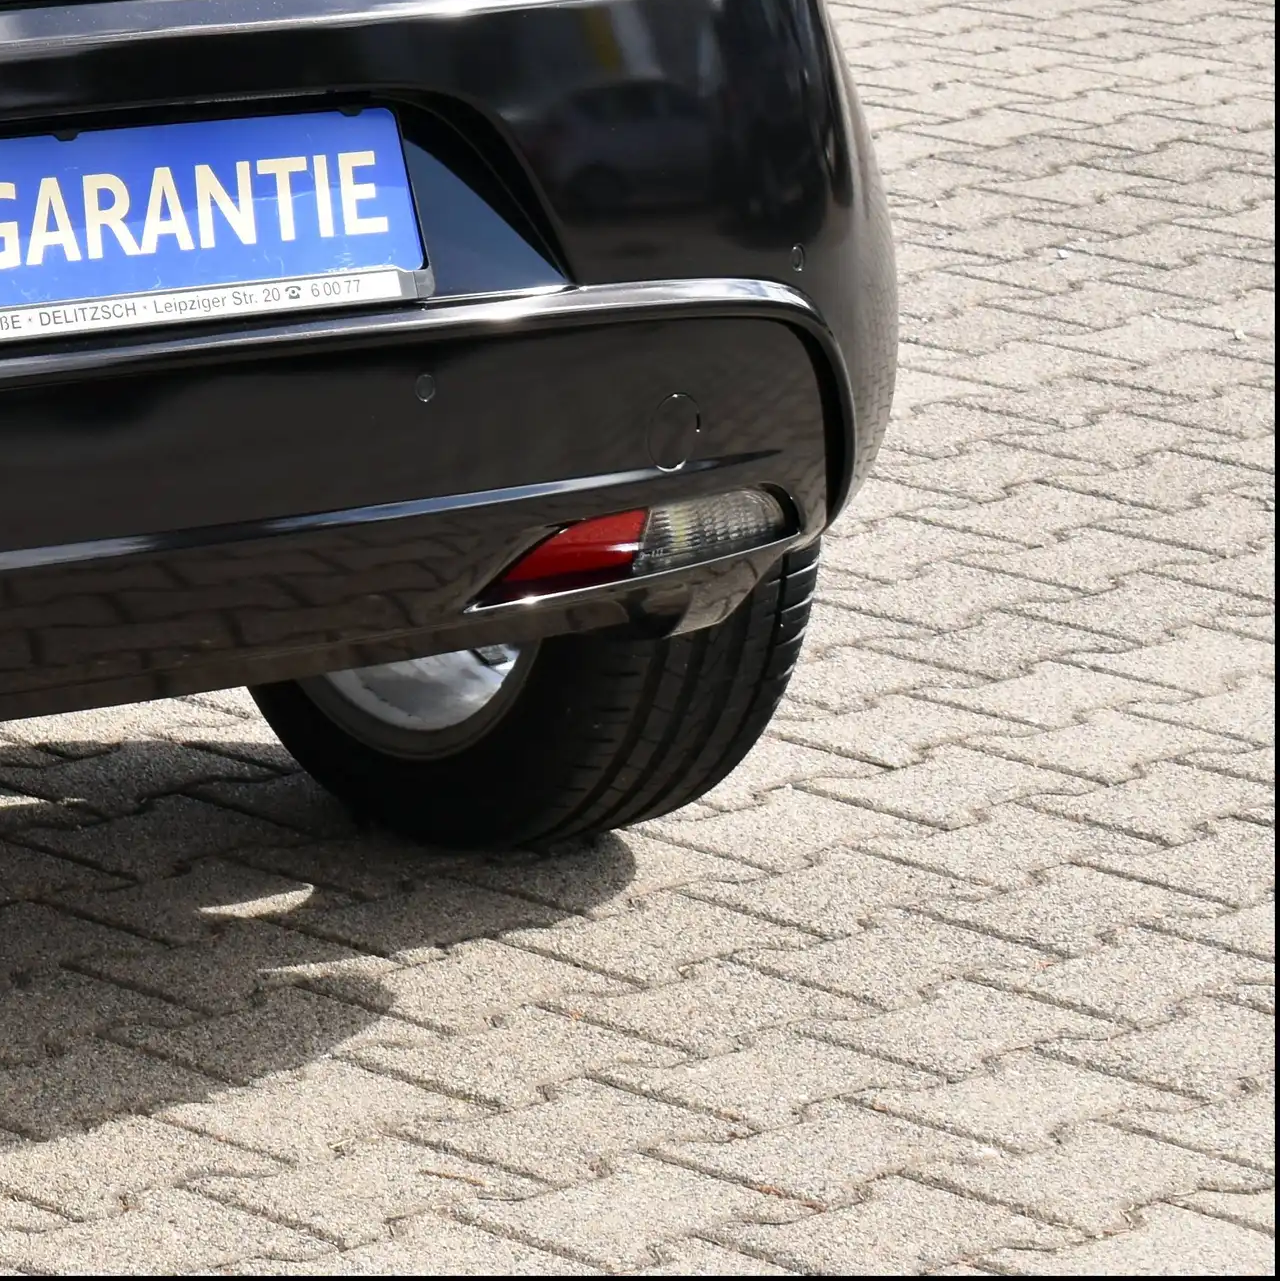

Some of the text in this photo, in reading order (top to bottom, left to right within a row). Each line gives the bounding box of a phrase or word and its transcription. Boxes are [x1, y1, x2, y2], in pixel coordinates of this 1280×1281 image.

[39, 301, 138, 327] DELITZSCH
[153, 294, 228, 315] Leipziger
[232, 290, 258, 307] Str.
[262, 287, 281, 304] 20
